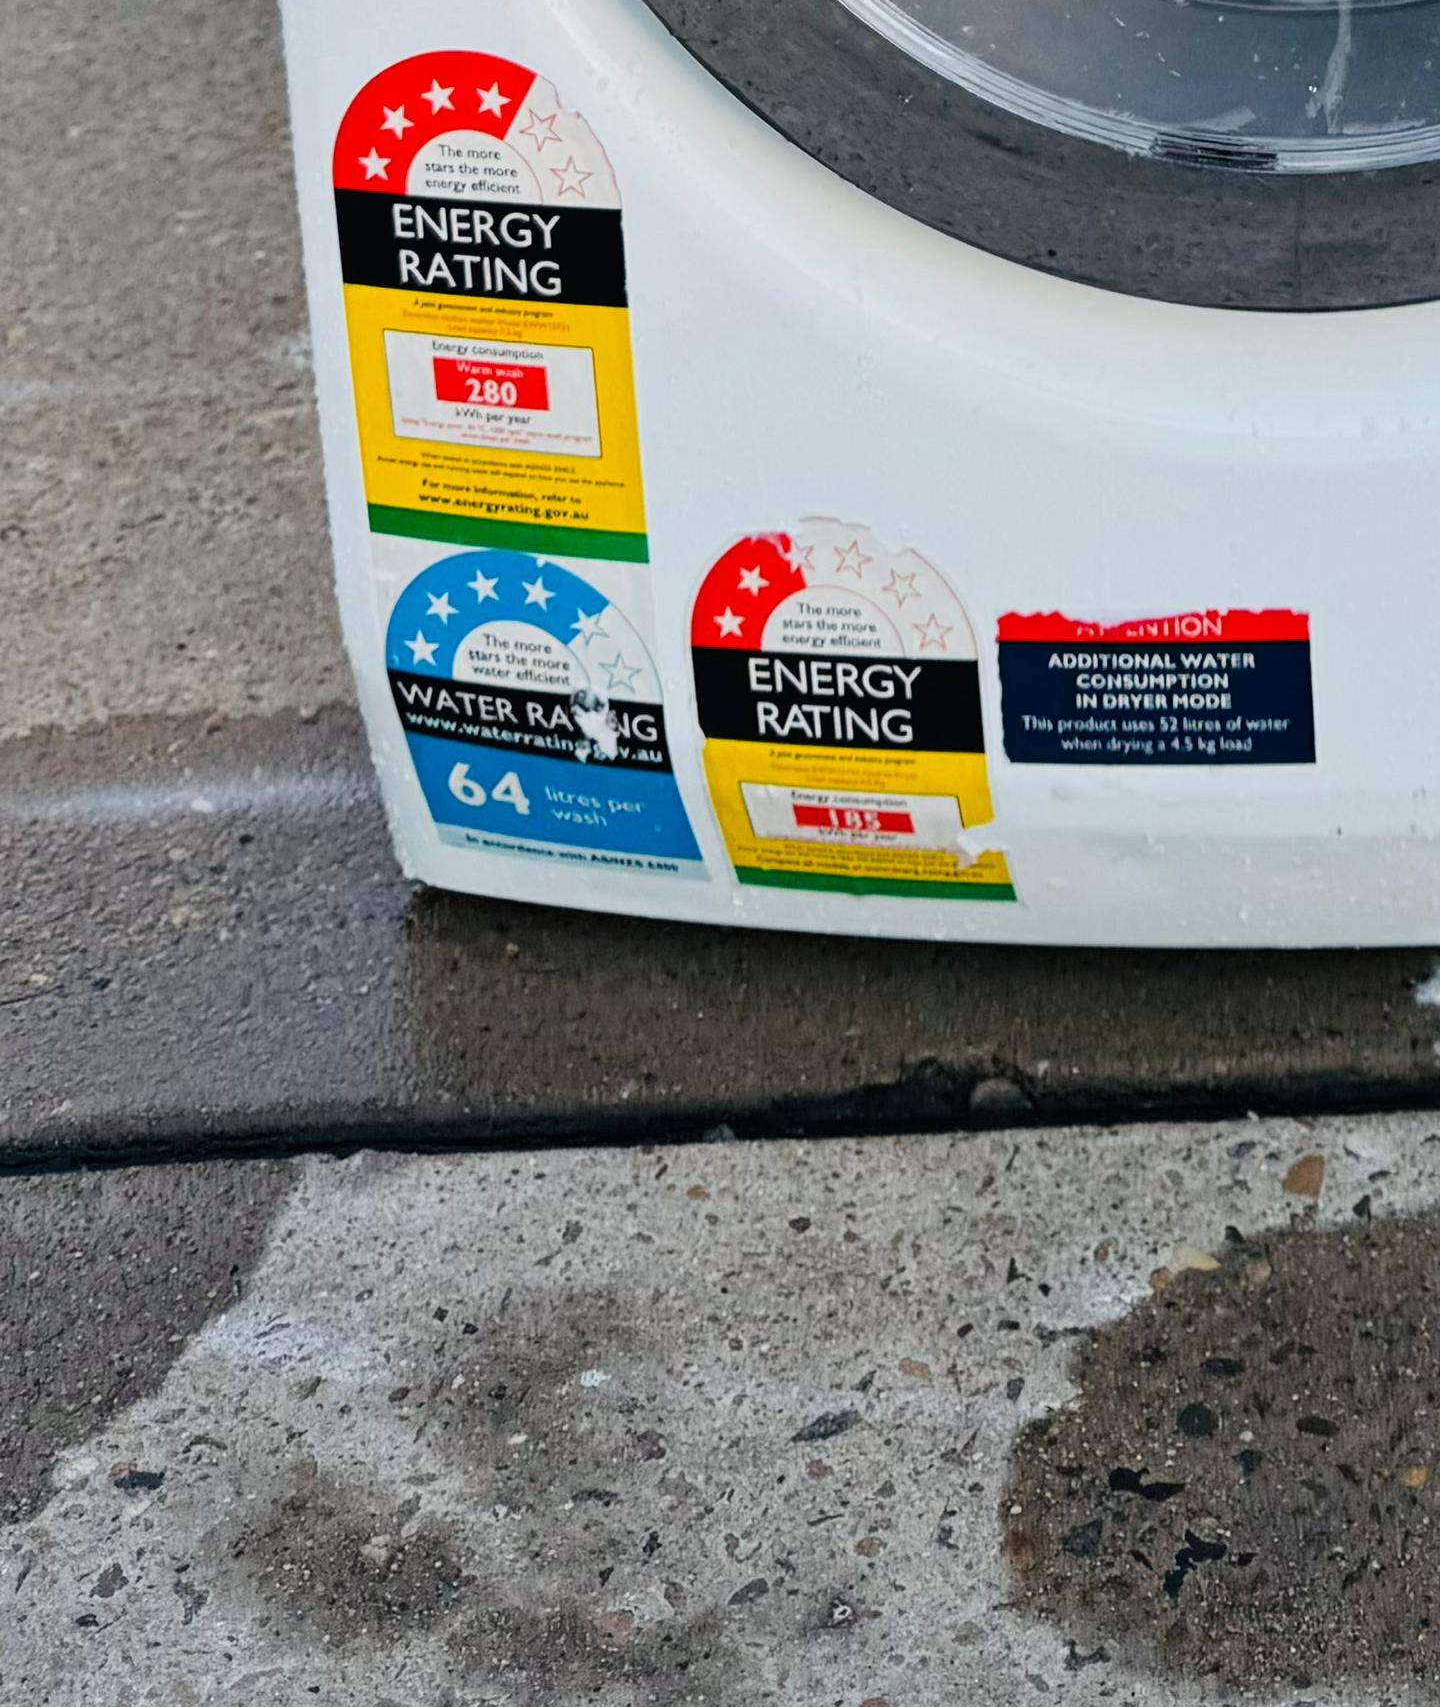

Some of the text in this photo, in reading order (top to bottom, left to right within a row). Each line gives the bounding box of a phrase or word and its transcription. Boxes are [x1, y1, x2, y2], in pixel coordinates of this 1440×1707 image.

[438, 143, 501, 160] The more
[425, 162, 518, 177] stars the more
[425, 179, 520, 194] energy efficient
[392, 203, 561, 250] ENERGY
[399, 249, 562, 297] RATING
[432, 340, 543, 361] Energy consumption
[456, 360, 524, 378] Warm wash
[464, 377, 518, 406] 280
[486, 411, 504, 423] per
[507, 413, 531, 425] year
[797, 601, 861, 617] The more
[783, 619, 877, 632] stars the more
[482, 633, 551, 654] The more
[783, 635, 882, 648] energy efficient
[468, 650, 570, 671] stars the more
[1048, 652, 1255, 669] ADDITIONAL WATER
[472, 666, 570, 686] water efficient
[747, 658, 922, 699] ENERGY
[1076, 673, 1229, 690] CONSUMPTION
[397, 681, 518, 724] WATER
[1076, 693, 1232, 710] IN DRYER MODE
[757, 701, 913, 744] RATING
[1021, 715, 1291, 734] This product uses 52 litres of water
[1061, 736, 1253, 755] when drying a 4.5 kg load
[448, 762, 530, 815] 64
[545, 785, 644, 813] litres per
[552, 809, 607, 826] wash
